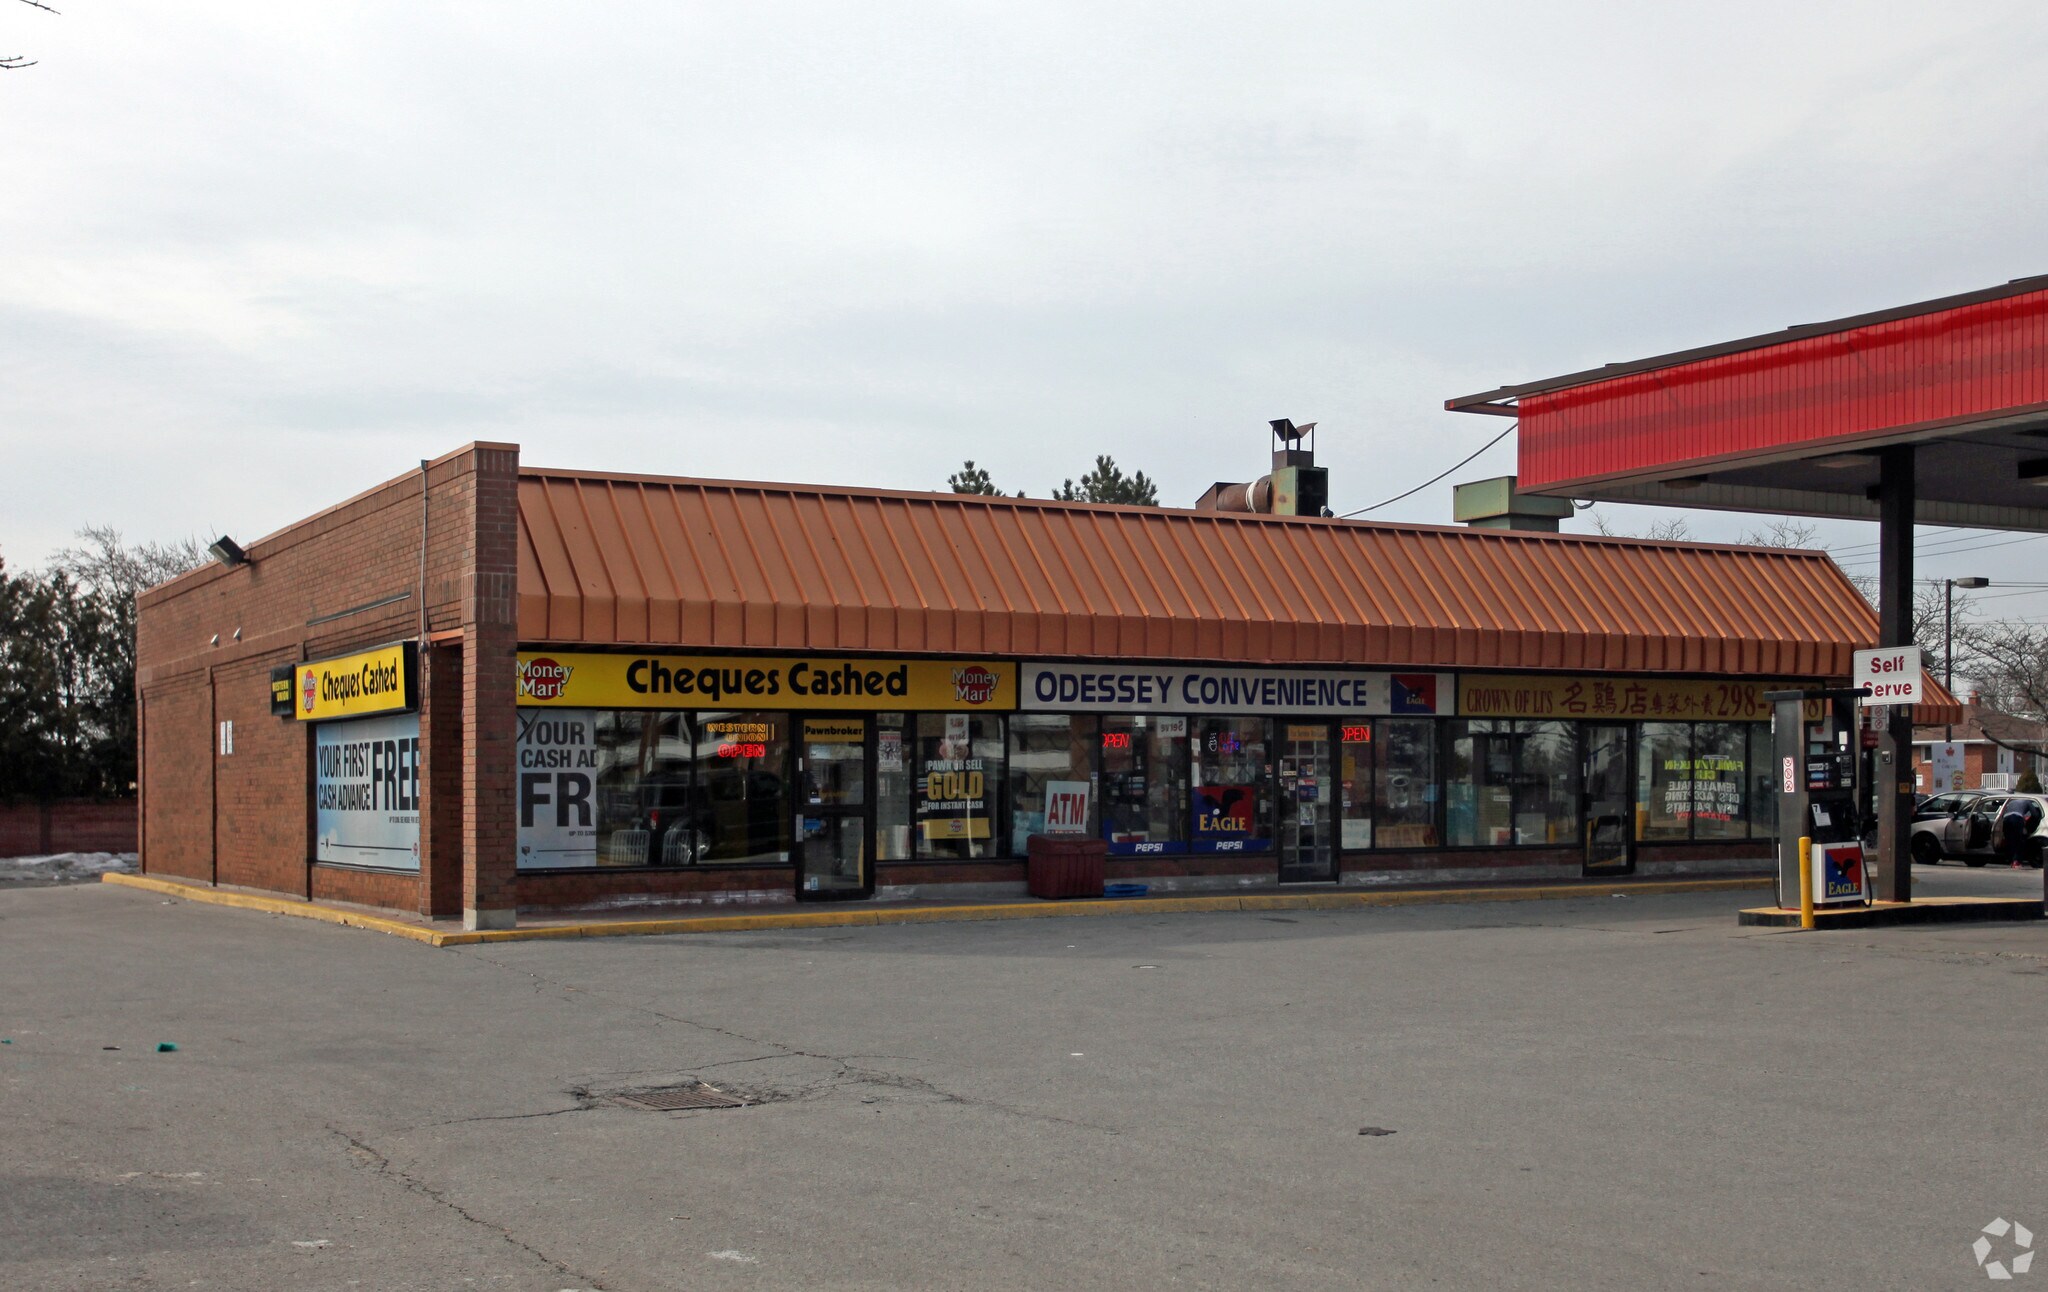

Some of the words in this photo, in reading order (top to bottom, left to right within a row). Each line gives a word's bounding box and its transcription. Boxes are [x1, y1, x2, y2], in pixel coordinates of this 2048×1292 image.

[516, 660, 574, 685] Money
[1870, 656, 1904, 673] Self
[322, 671, 360, 706] Cheques
[361, 658, 398, 695] Cashed
[518, 679, 564, 697] Mart
[626, 660, 780, 702] Cheques
[788, 662, 908, 696] Cashed
[952, 668, 999, 690] Money
[955, 685, 992, 701] Mart
[1035, 671, 1173, 704] ODESSEY
[1182, 674, 1367, 706] CONVENIENCE
[1467, 688, 1510, 713] CROWN
[1514, 689, 1530, 713] OF
[1533, 689, 1553, 714] LI'S
[521, 721, 586, 745] YOUR
[706, 723, 766, 732] WESTERN
[805, 726, 863, 736] Pawnbroker
[726, 733, 766, 741] UNION
[319, 745, 341, 778] YOUR
[343, 742, 370, 777] FIRST
[521, 749, 572, 768] CASH
[718, 744, 765, 758] OPEN
[928, 760, 952, 770] PAWN
[965, 759, 983, 770] SELL
[372, 737, 420, 811] FREE
[927, 771, 984, 800] GOLD
[319, 784, 337, 810] CASH
[338, 783, 370, 811] ADVANCE
[521, 772, 593, 828] FR
[928, 802, 940, 810] FOR
[941, 801, 966, 810] INSTANT
[967, 800, 983, 809] CASH
[1048, 793, 1085, 825] ATM
[1813, 805, 1818, 813] 7
[1200, 814, 1246, 831] EAGLE
[1135, 843, 1163, 852] PEPSI
[1216, 841, 1243, 850] PEPSI
[1828, 882, 1858, 895] EAGLE
